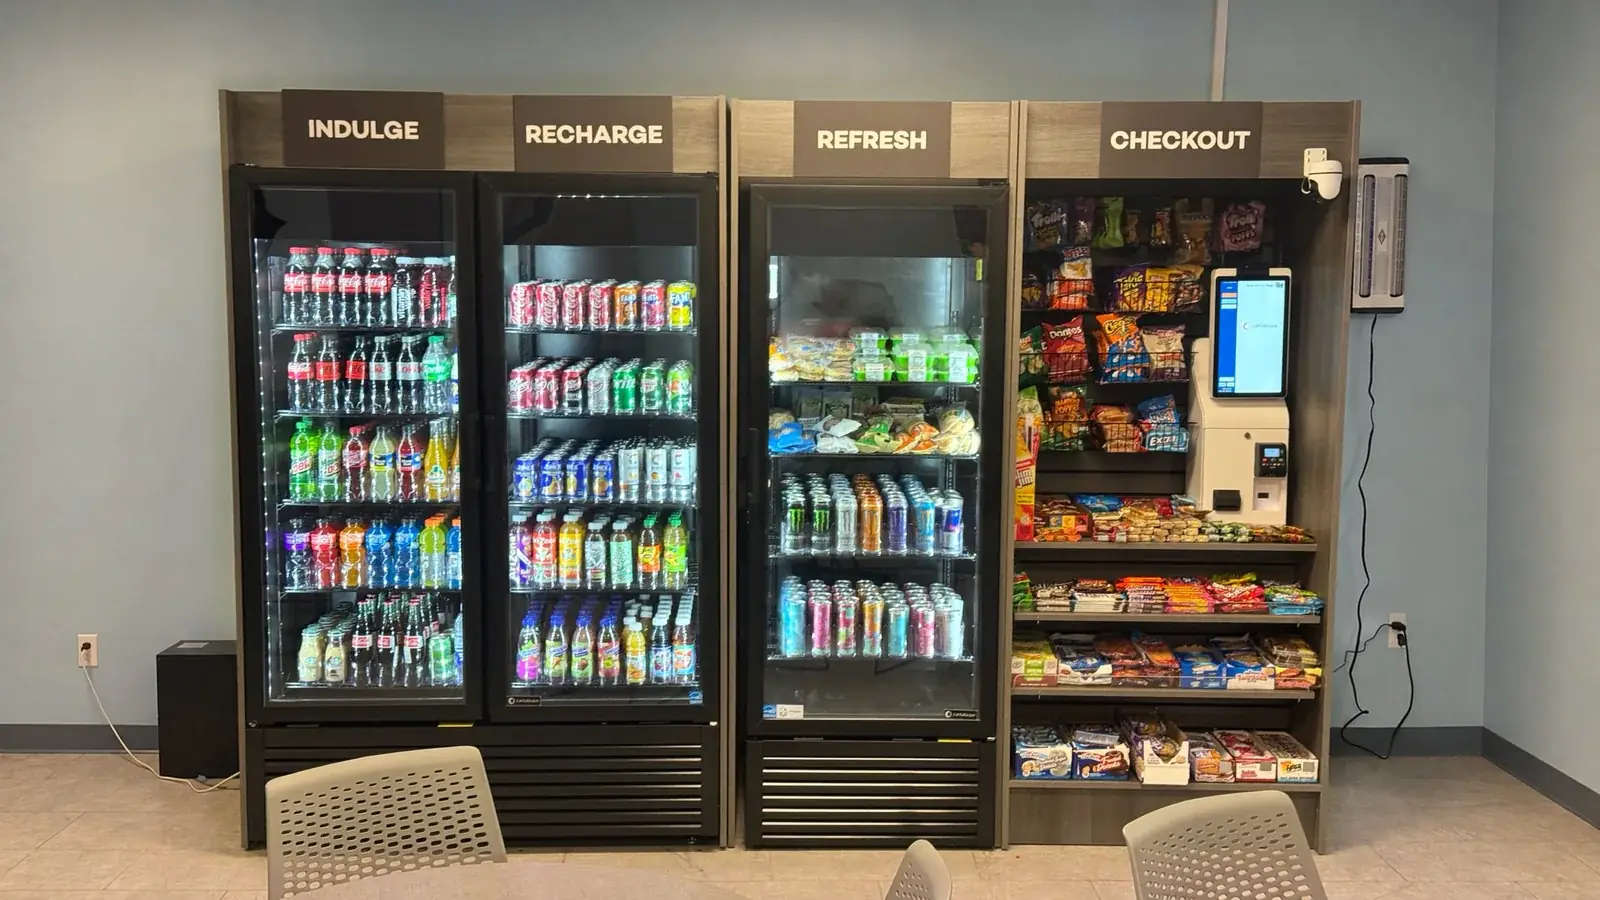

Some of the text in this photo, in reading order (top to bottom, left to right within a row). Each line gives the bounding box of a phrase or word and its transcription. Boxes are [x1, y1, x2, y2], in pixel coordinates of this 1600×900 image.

[307, 119, 420, 141] INDULGE
[524, 124, 664, 146] RECHARGE
[817, 129, 928, 151] REFRESH
[1110, 130, 1252, 151] CHECKOUT
[1049, 325, 1082, 340] Doritos
